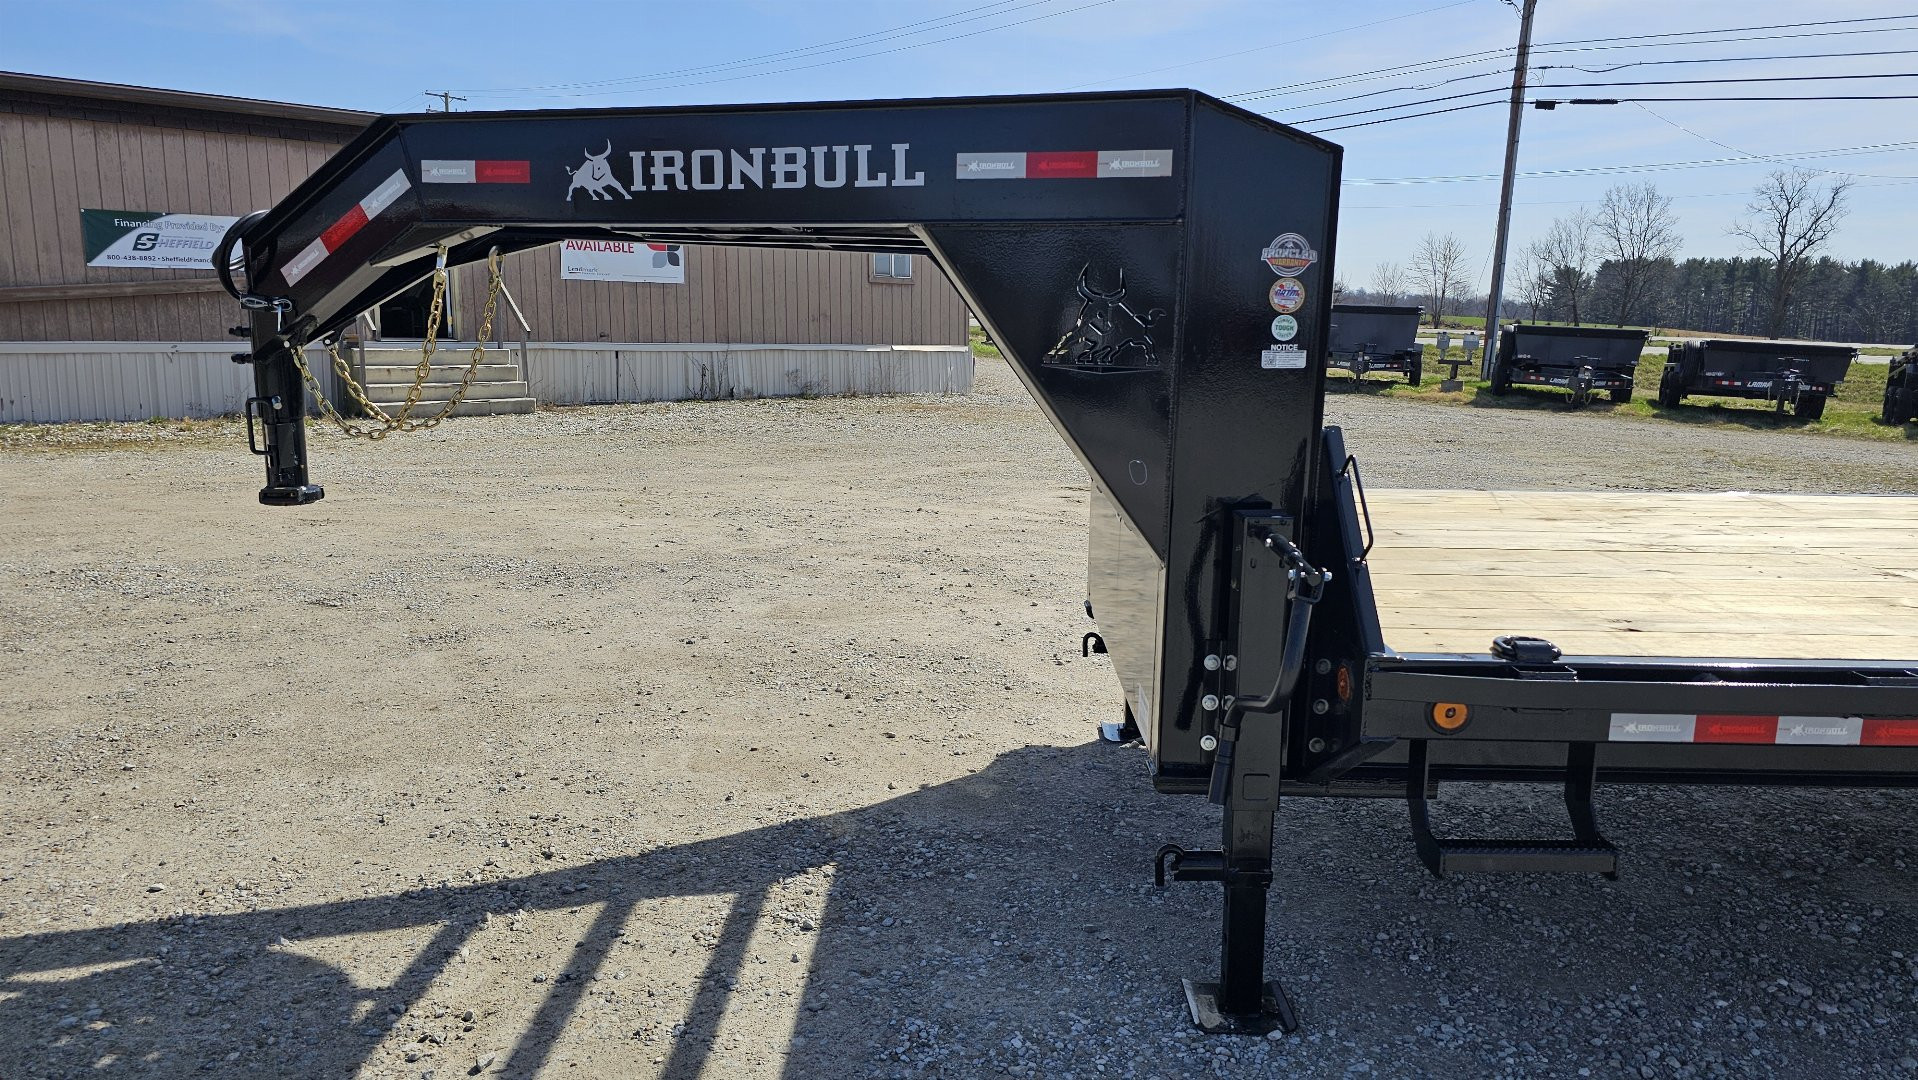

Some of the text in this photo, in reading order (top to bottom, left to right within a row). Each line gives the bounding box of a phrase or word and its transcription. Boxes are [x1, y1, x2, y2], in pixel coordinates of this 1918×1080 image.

[629, 143, 925, 192] IRONBULL
[115, 218, 226, 234] Financing Provided By:
[133, 233, 215, 251] SHEFFIELD
[565, 240, 635, 253] AVAILABLE
[106, 254, 156, 262] 800-438-8892
[1262, 248, 1317, 261] IRONCLAD
[1270, 343, 1299, 351] NOTICE
